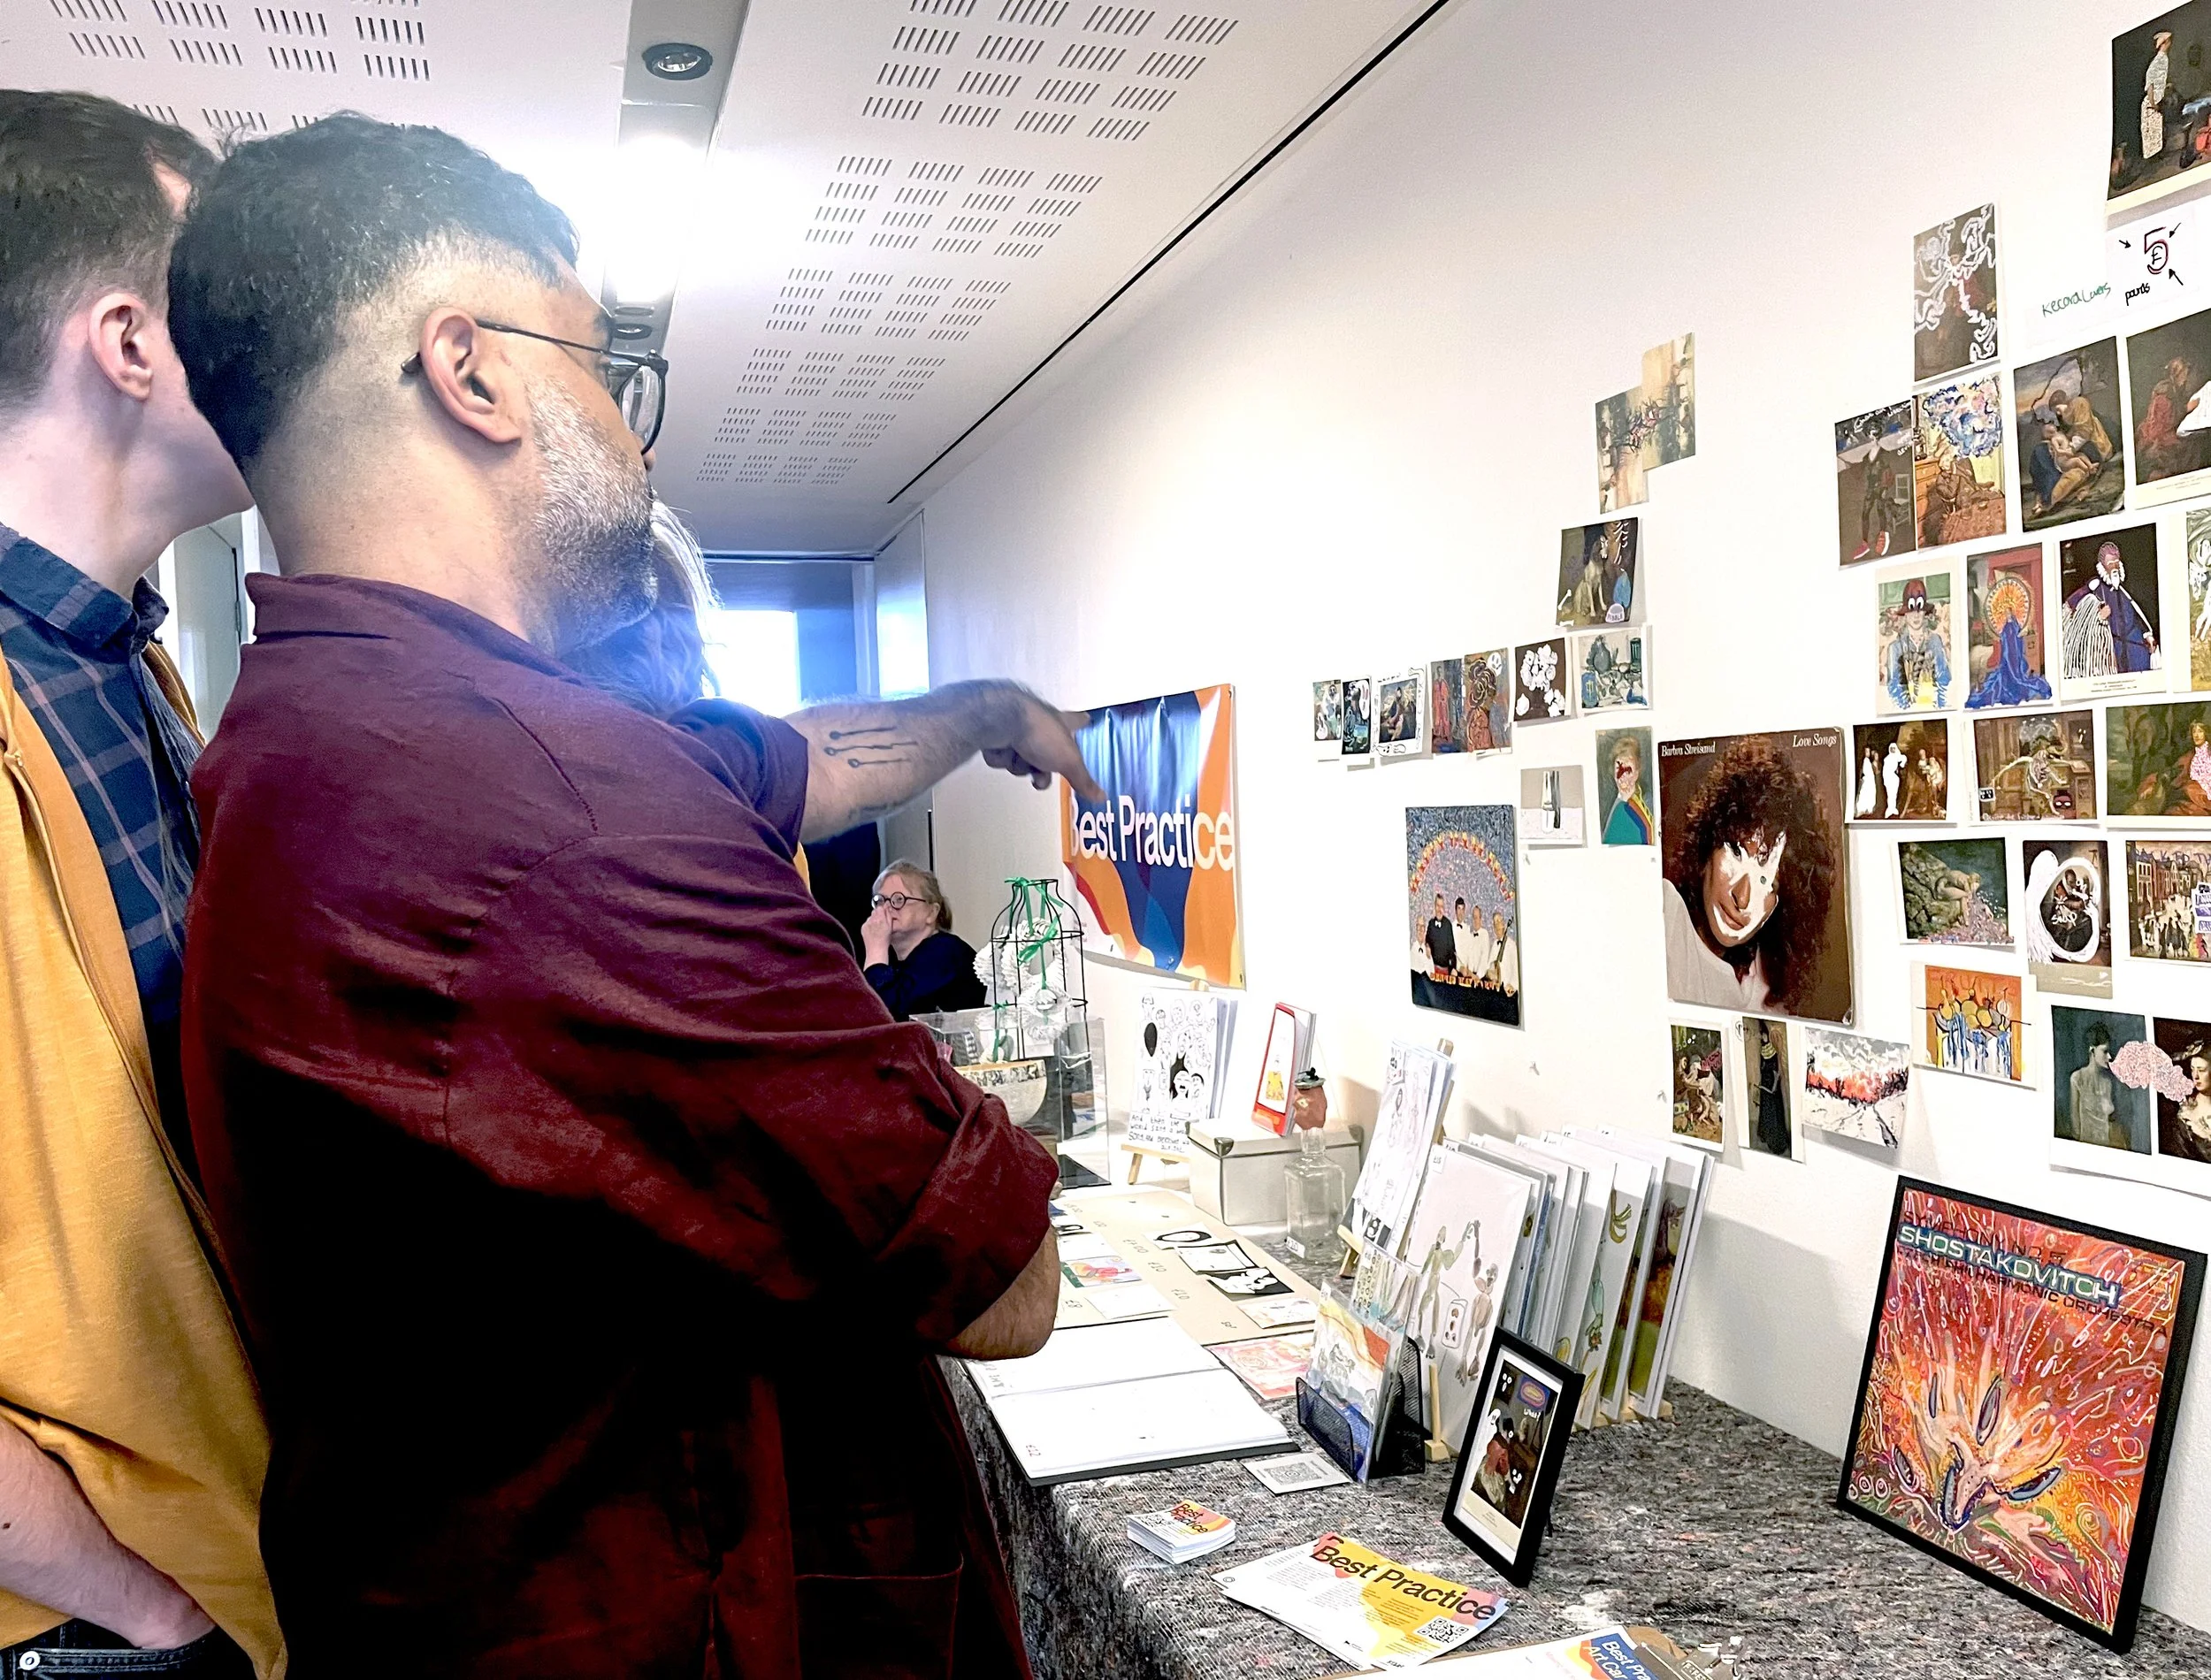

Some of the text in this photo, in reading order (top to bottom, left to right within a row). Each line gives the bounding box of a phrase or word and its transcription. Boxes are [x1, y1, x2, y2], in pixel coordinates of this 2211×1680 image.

[1684, 741, 1716, 756] Streisand
[1793, 733, 1837, 749] Love Songs
[1070, 792, 1235, 872] Best Practice
[1899, 1225, 2117, 1306] SHOSTAKOVITCH
[1172, 1503, 1204, 1519] Best
[1309, 1545, 1378, 1578] Best
[1373, 1569, 1496, 1620] Practice
[1583, 1646, 1609, 1662] Art
[1601, 1640, 1635, 1666] Best
